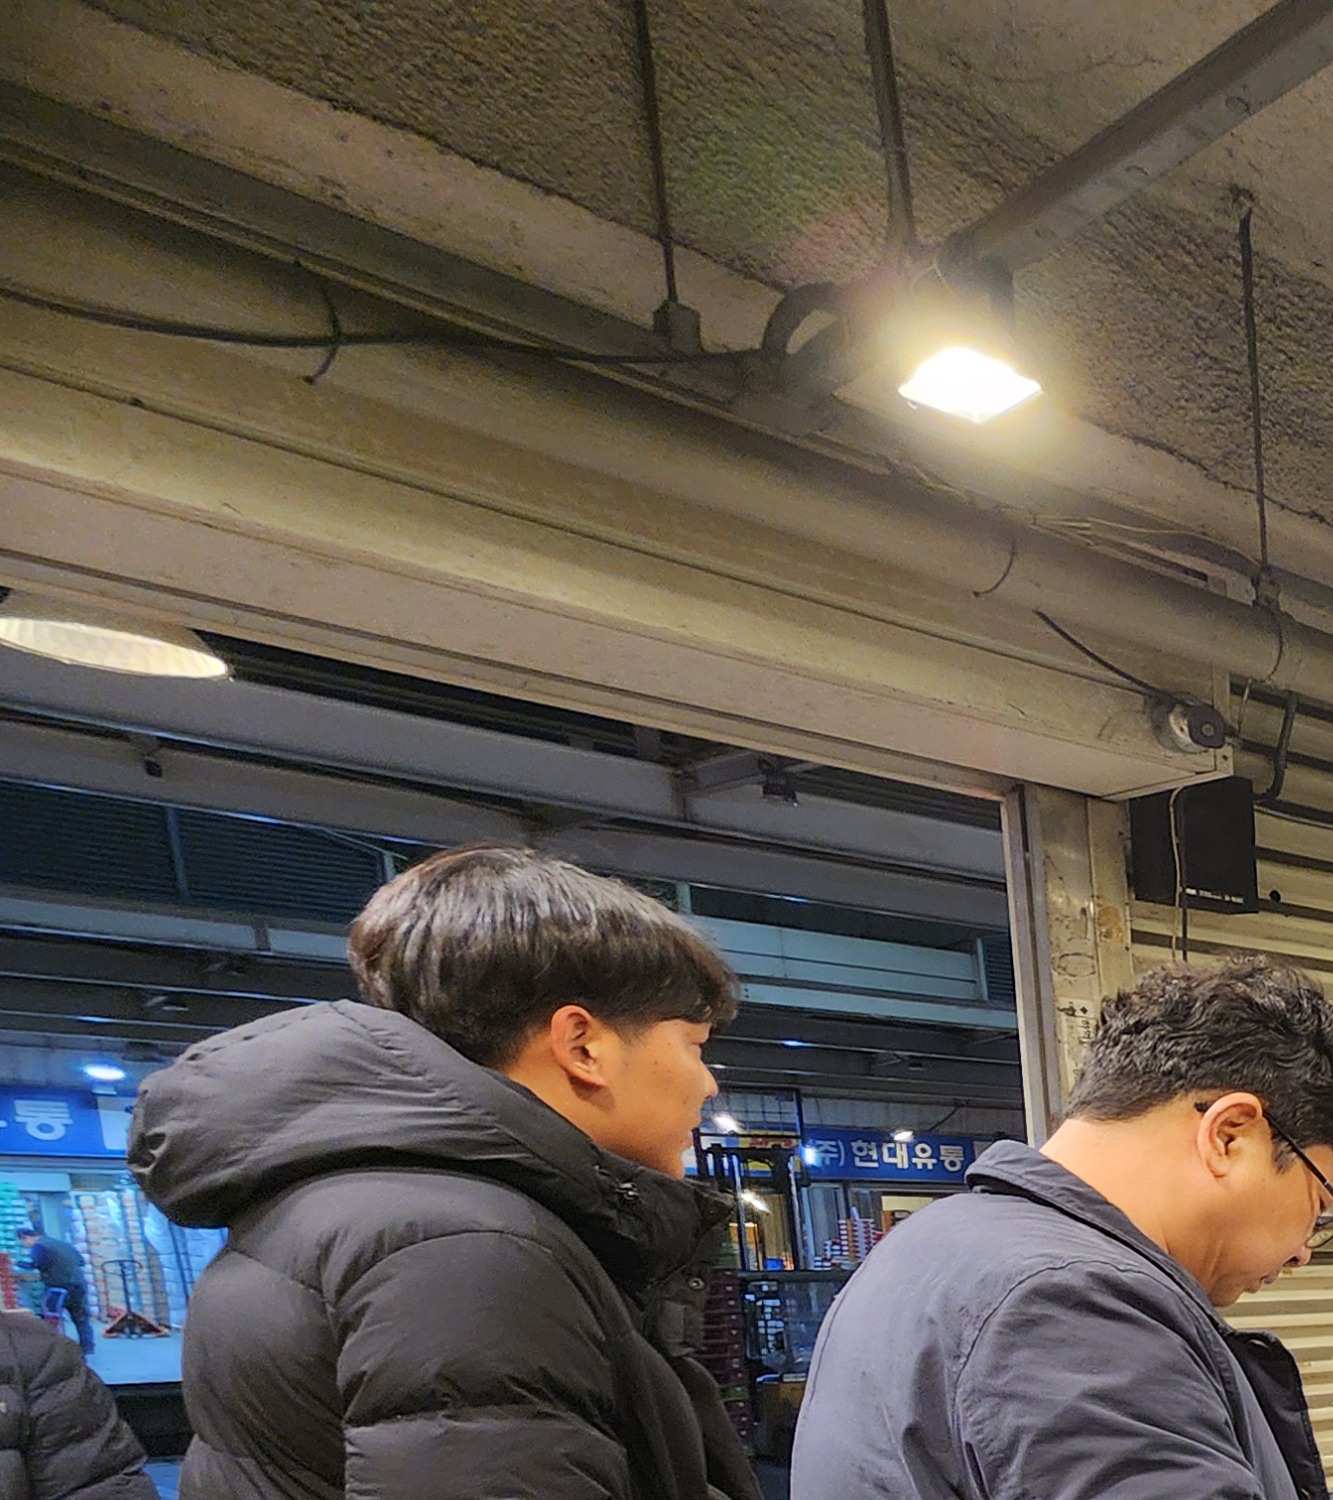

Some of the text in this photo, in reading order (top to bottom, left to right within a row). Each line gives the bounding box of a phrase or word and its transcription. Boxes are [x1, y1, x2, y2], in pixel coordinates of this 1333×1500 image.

[0, 1099, 74, 1141] 통
[803, 1139, 845, 1168] 주)
[850, 1139, 966, 1172] 현대유통
